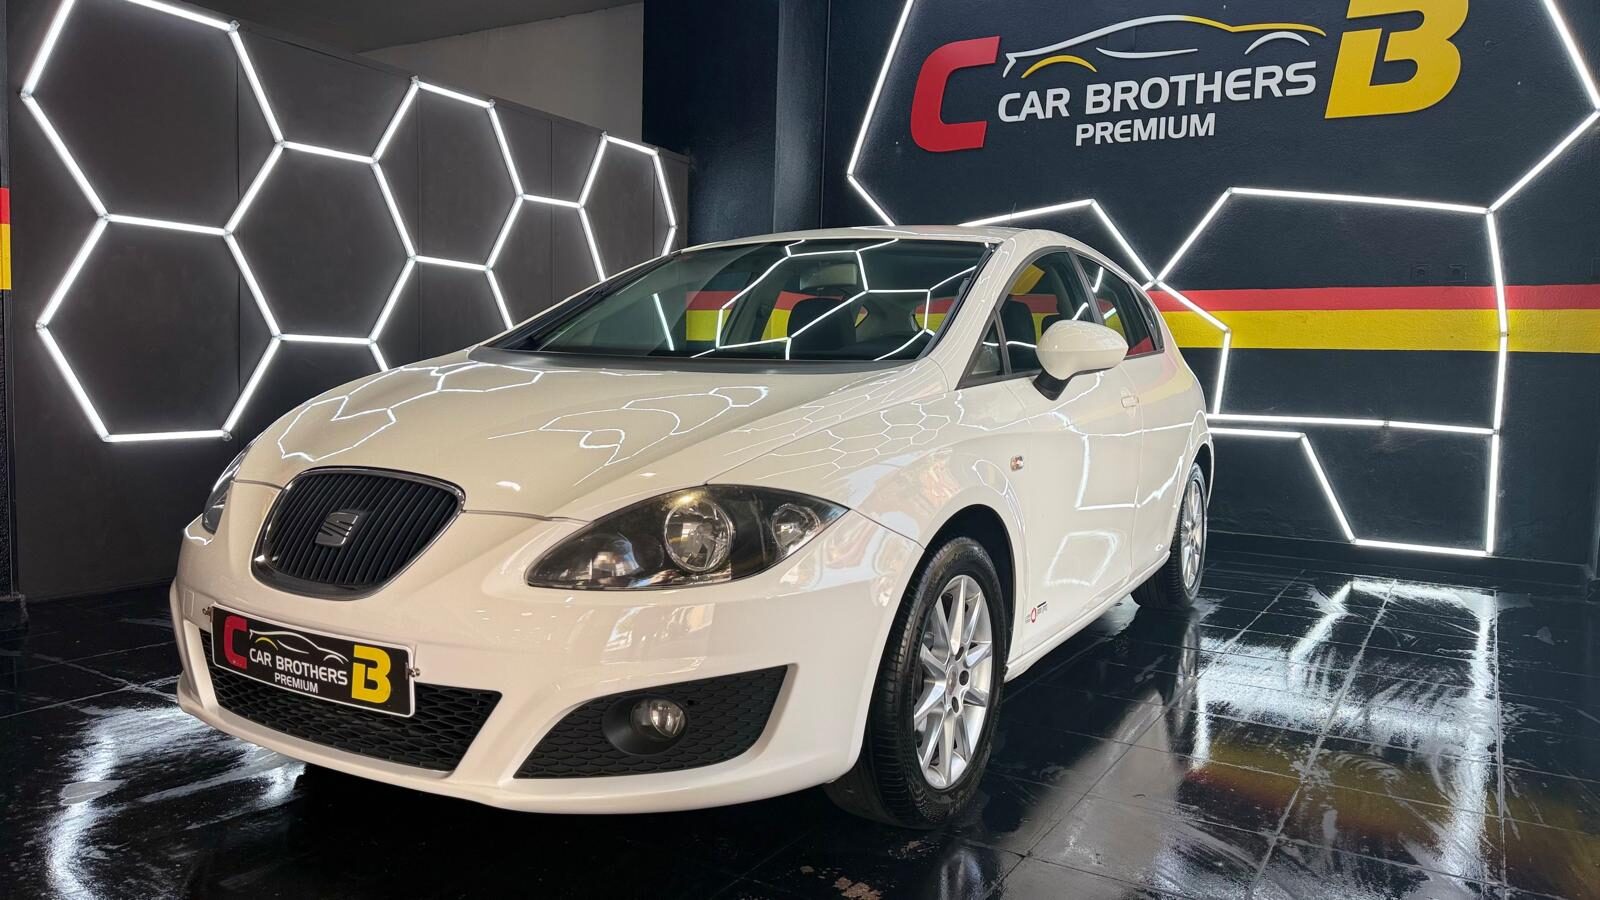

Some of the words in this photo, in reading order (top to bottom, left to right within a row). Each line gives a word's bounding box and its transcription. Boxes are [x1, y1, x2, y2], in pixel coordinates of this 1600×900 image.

[910, 36, 1001, 152] C
[998, 87, 1071, 123] CAR
[1085, 61, 1317, 115] BROTHERS
[1075, 112, 1216, 147] PREMIUM
[223, 615, 247, 670] C
[250, 648, 272, 668] CAR
[276, 656, 348, 686] BROTHERS
[274, 672, 319, 694] PREMIUM
